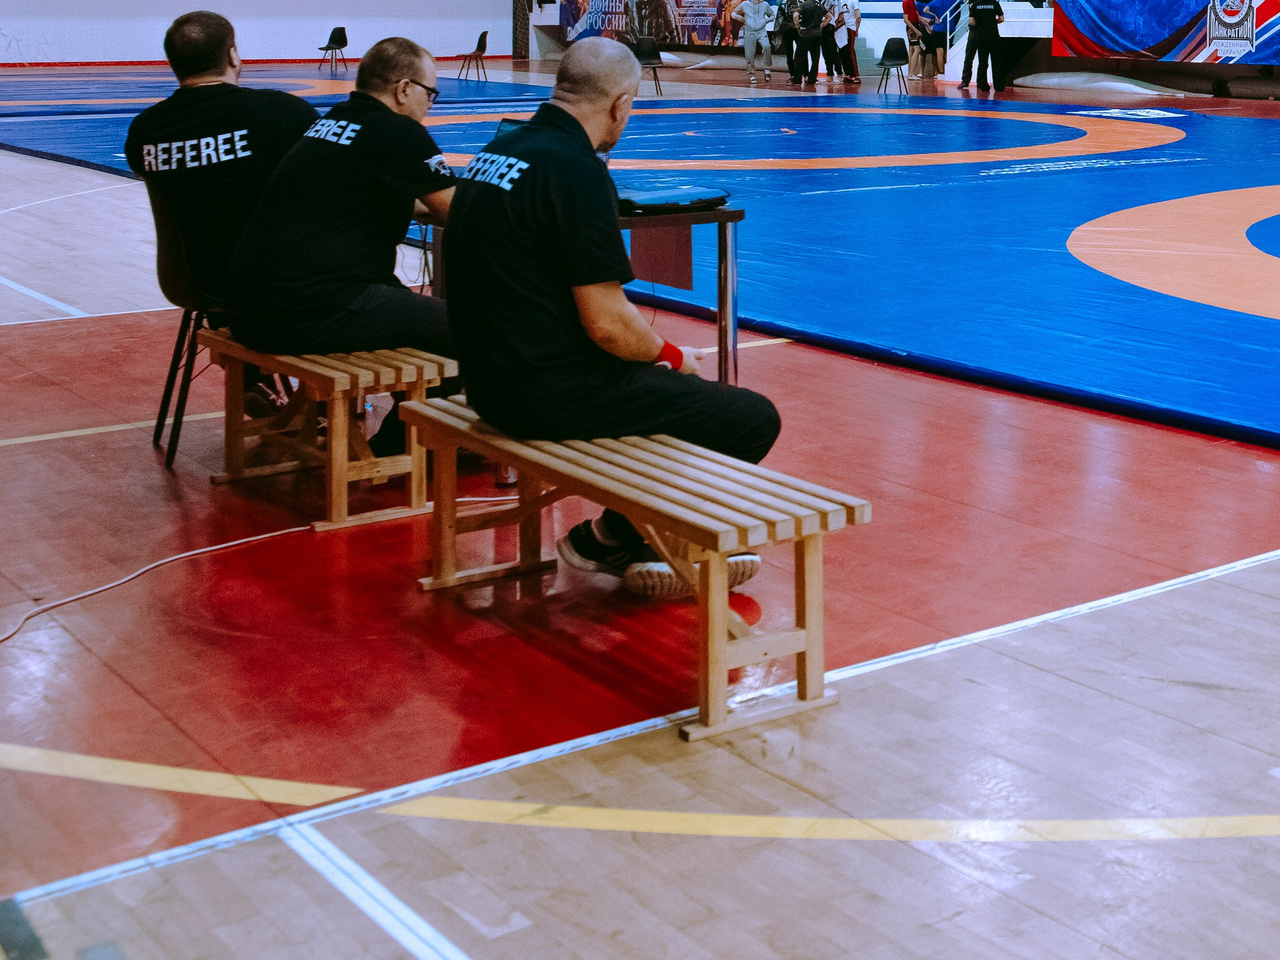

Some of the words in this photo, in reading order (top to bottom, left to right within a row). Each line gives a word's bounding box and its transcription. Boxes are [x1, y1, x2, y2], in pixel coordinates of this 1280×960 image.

[586, 14, 626, 31] РОССИИ
[304, 118, 362, 145] EREE
[143, 129, 253, 171] REFEREE
[462, 151, 531, 192] EFEREE
